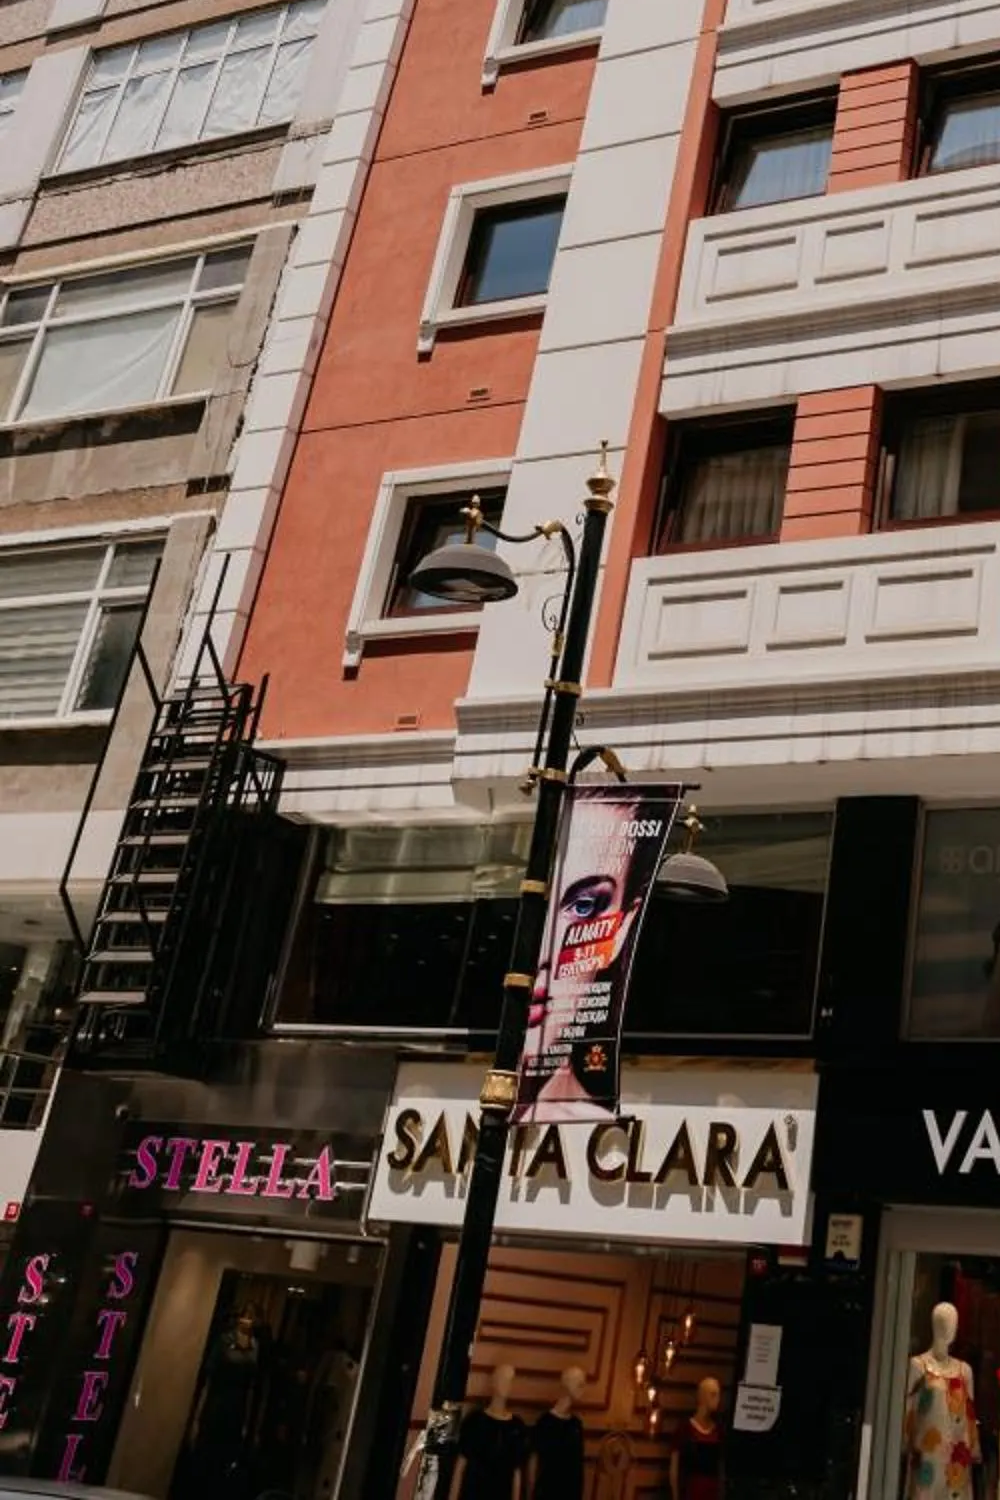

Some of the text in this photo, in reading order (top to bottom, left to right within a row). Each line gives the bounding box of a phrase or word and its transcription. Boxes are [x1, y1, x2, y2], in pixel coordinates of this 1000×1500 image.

[564, 917, 616, 947] ALMATY
[128, 1135, 336, 1201] STELLA
[586, 1118, 789, 1191] CLARA
